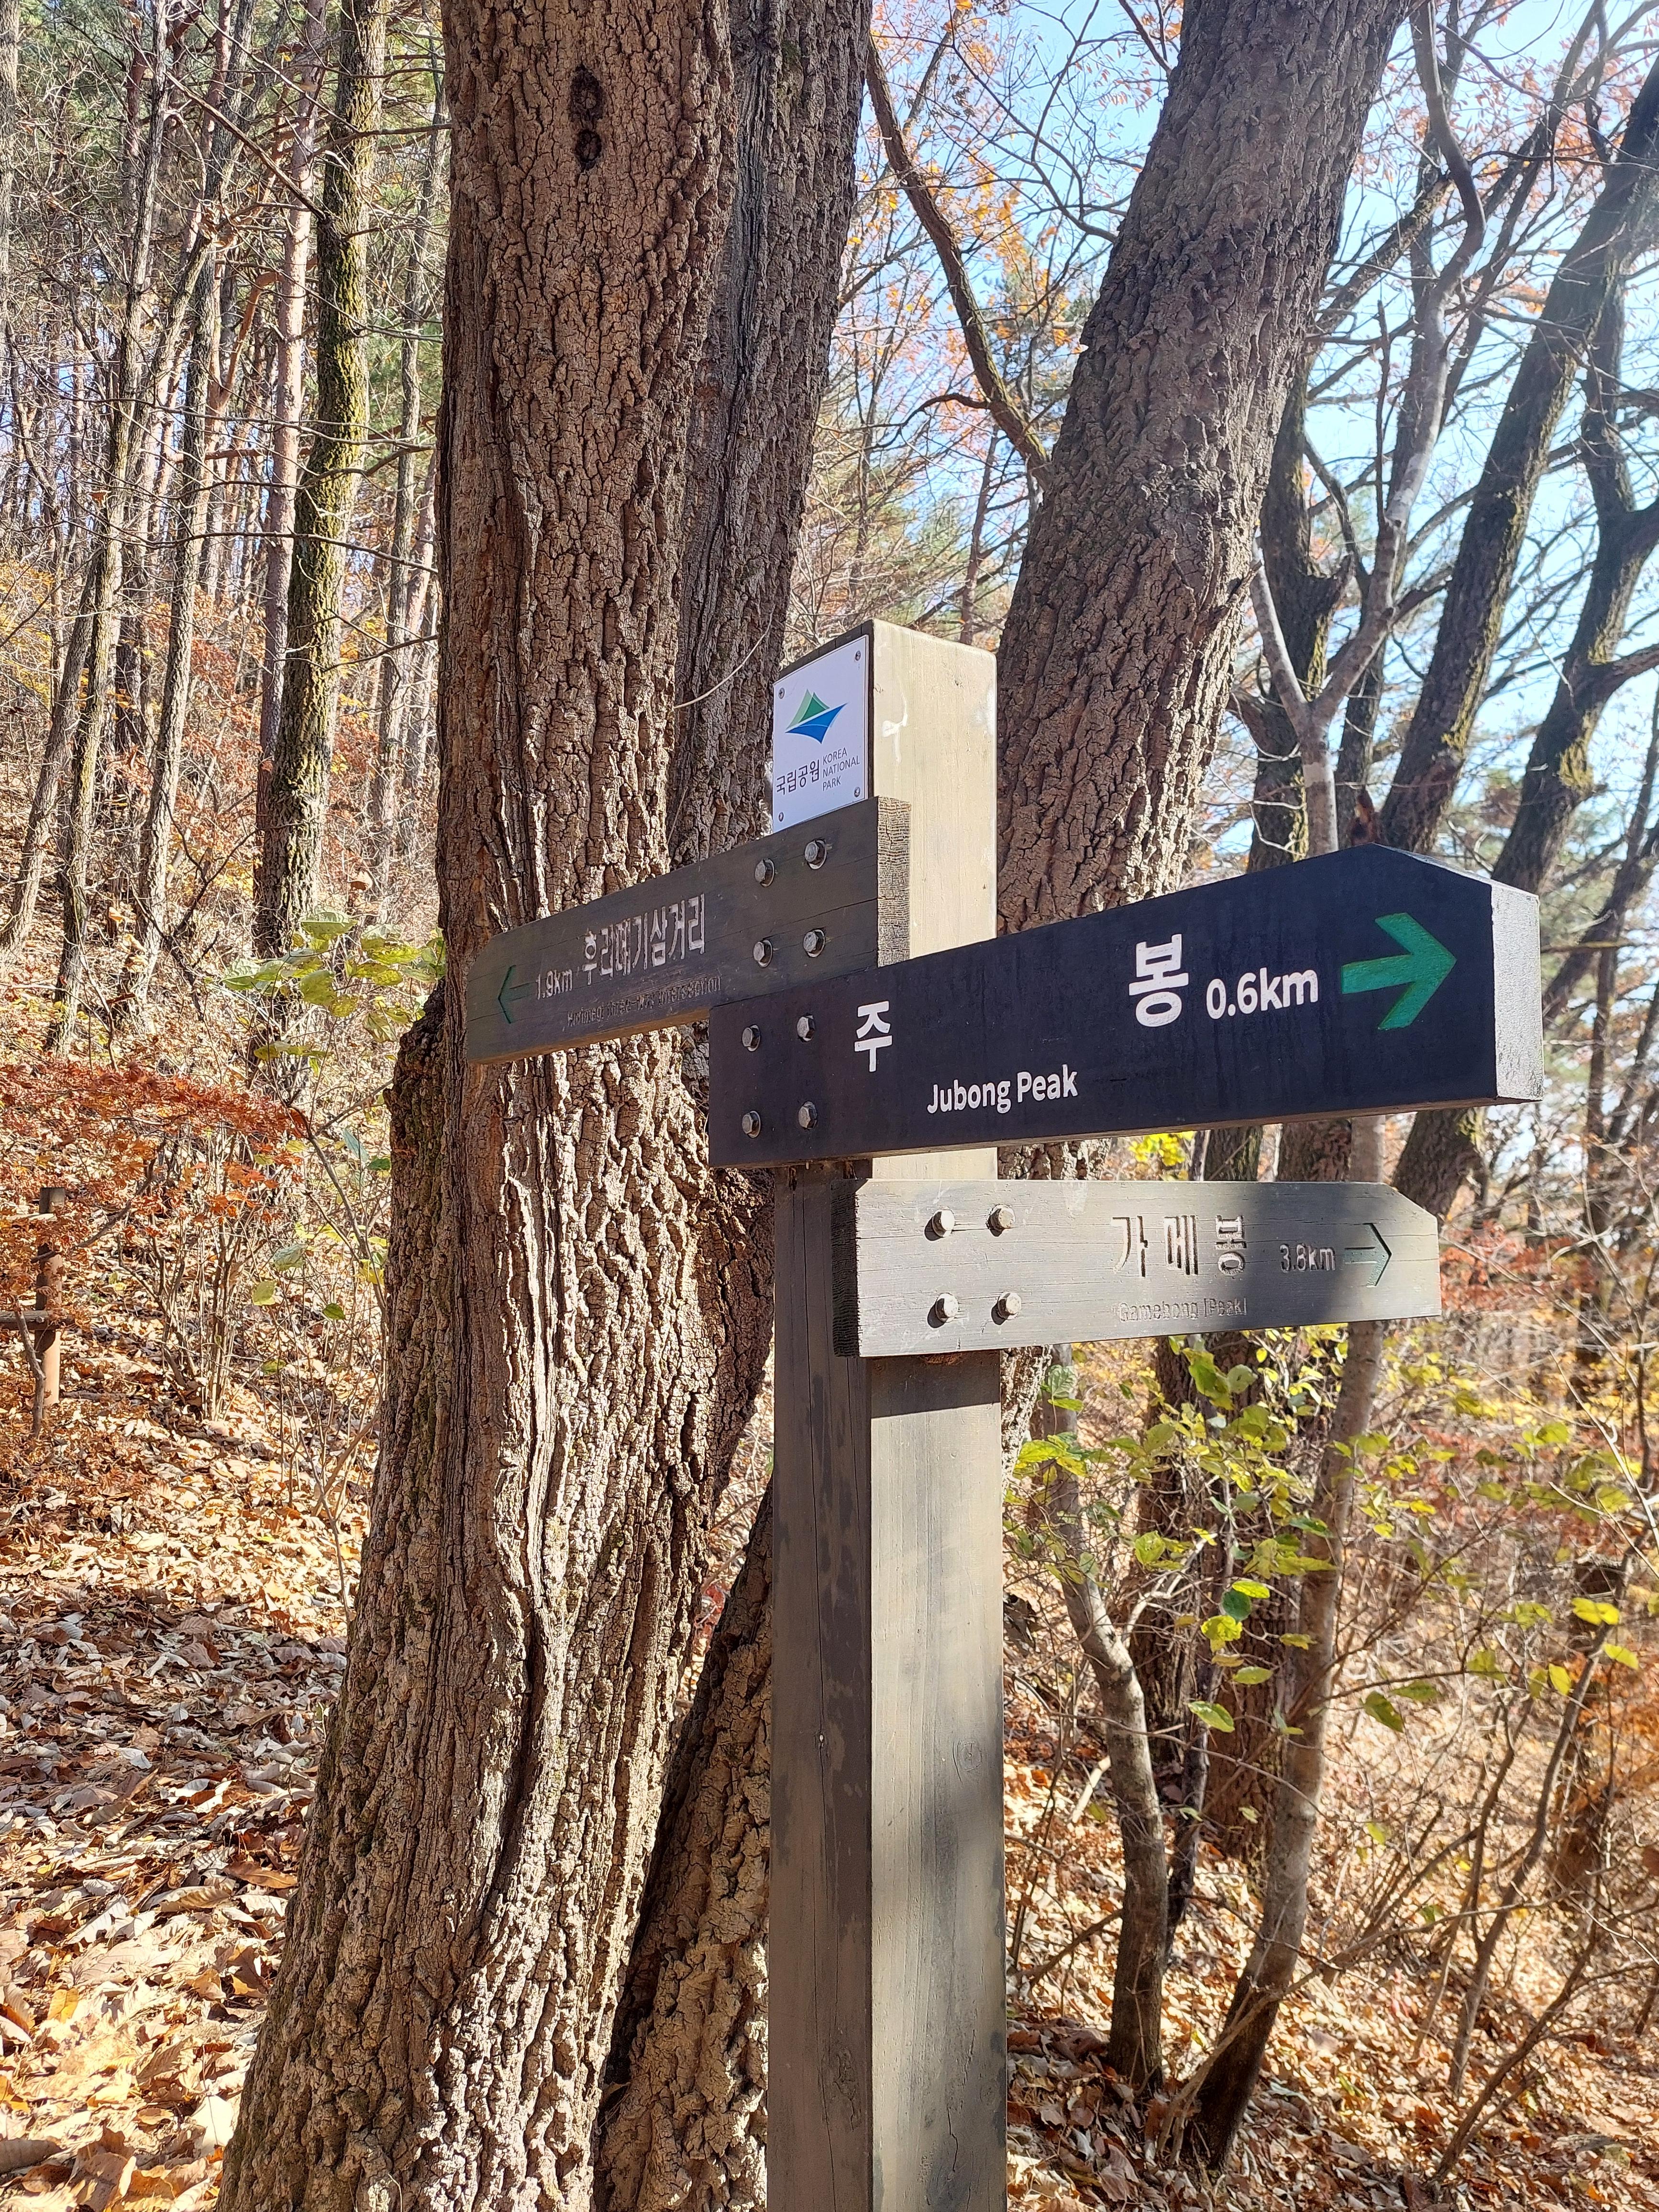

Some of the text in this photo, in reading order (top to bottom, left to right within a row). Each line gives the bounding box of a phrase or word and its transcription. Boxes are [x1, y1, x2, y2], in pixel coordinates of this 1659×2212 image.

[823, 747, 848, 765] KOREA
[823, 755, 860, 778] NATIONAL
[776, 759, 819, 795] 국립공원
[823, 775, 841, 792] PARK
[535, 969, 573, 1000] 1.9km
[854, 934, 1318, 1072] 주 봉 0.6km
[927, 1064, 1078, 1114] Jubong Peak
[1280, 1243, 1336, 1272] 3.8km
